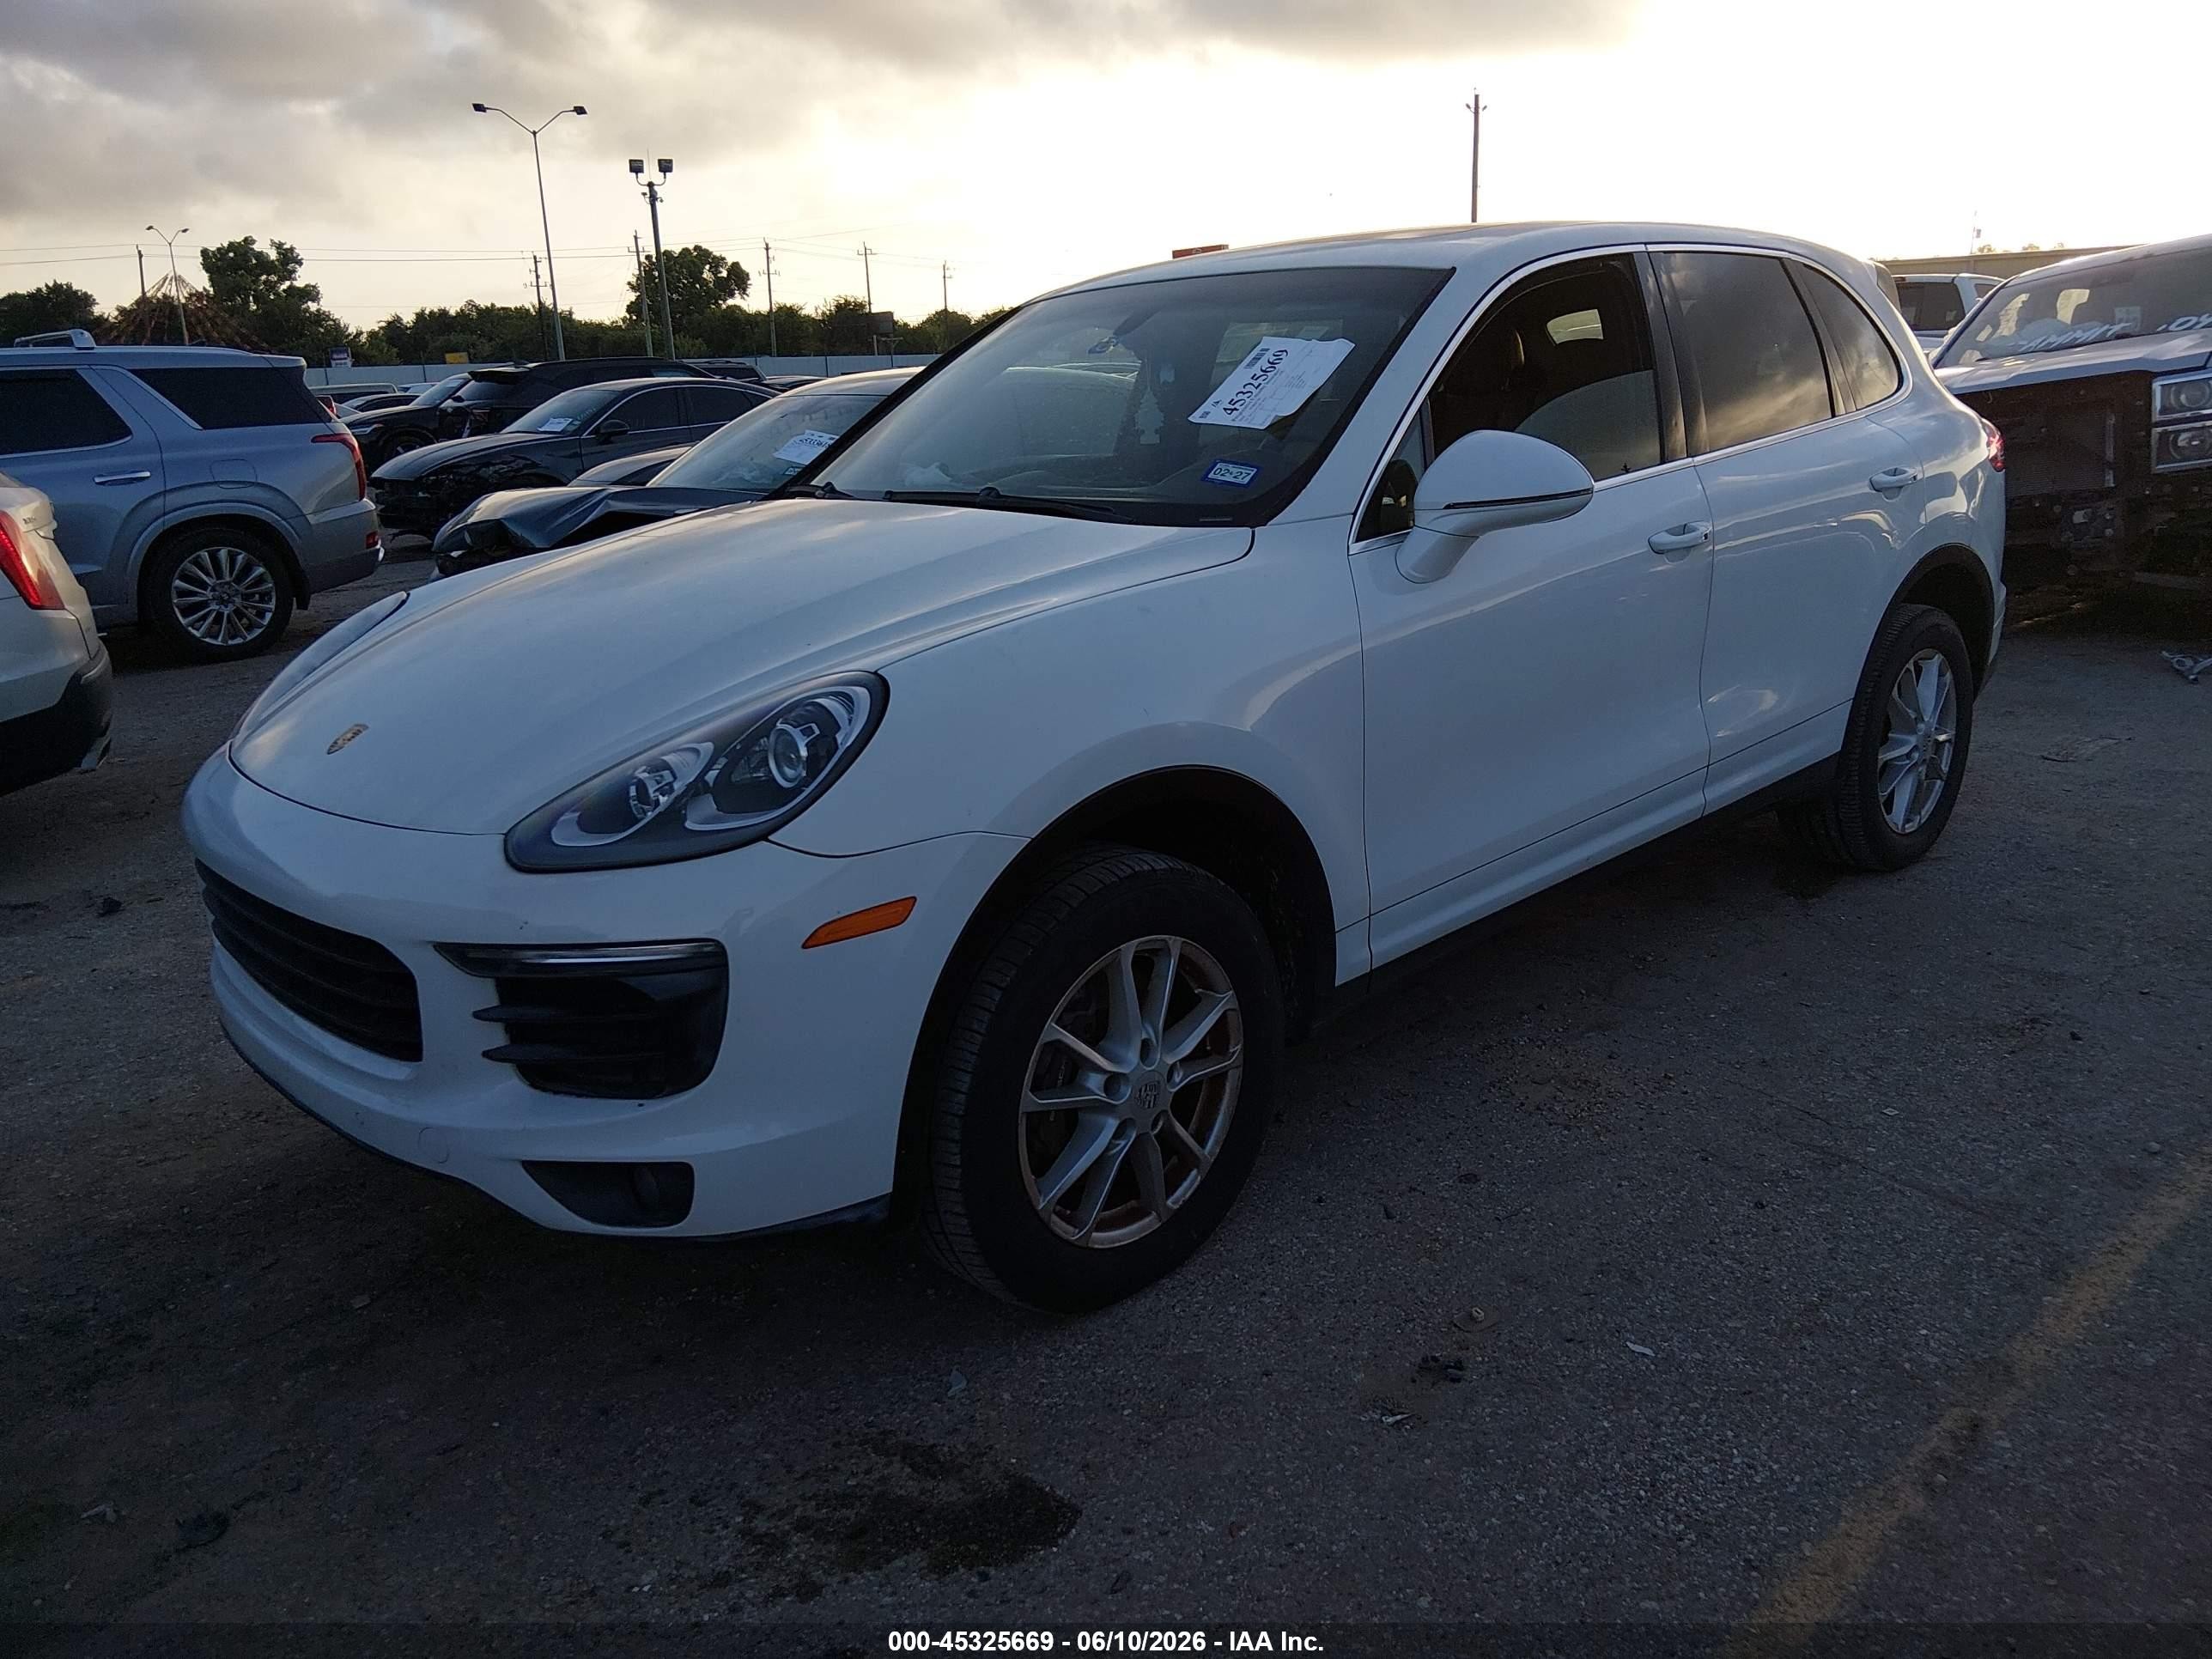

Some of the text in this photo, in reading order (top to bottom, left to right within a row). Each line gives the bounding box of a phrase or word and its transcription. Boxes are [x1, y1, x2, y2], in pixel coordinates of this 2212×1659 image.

[1222, 349, 1289, 416] 45325669
[1212, 467, 1252, 481] 02 27
